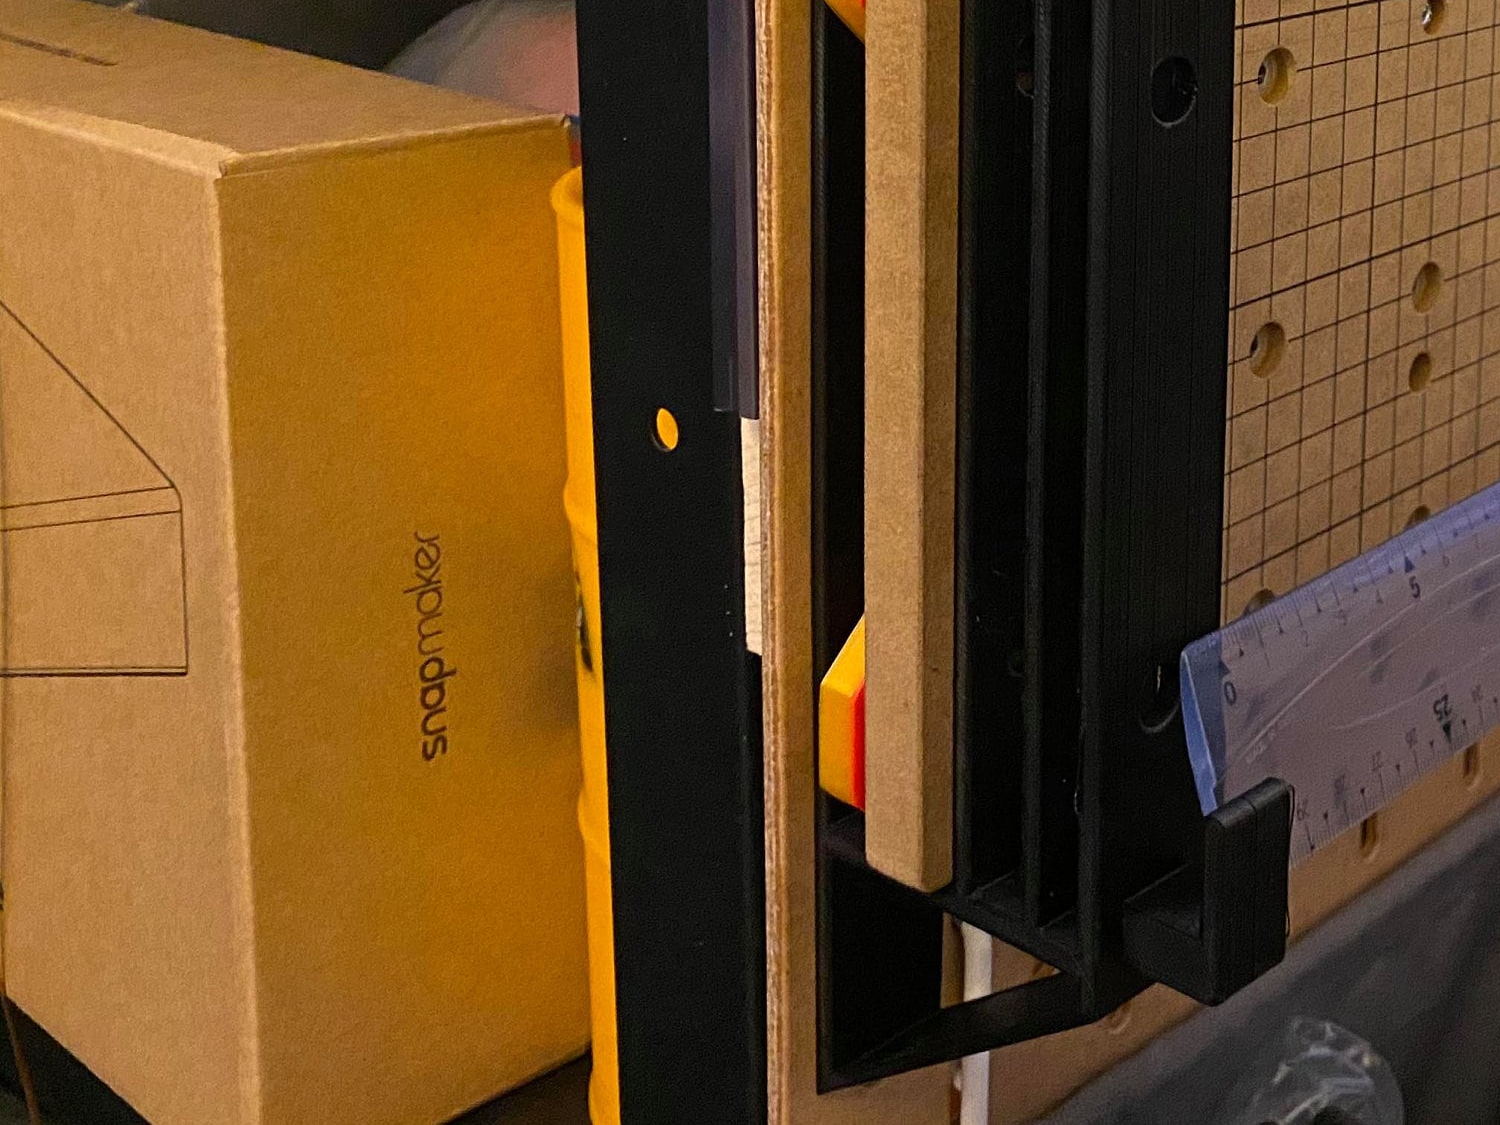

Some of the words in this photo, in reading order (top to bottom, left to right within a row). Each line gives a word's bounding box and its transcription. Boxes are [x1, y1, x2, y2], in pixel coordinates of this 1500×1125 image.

[1408, 575, 1421, 599] 5
[403, 530, 457, 762] snapmaker
[1224, 681, 1237, 706] 0
[1432, 693, 1452, 723] 25
